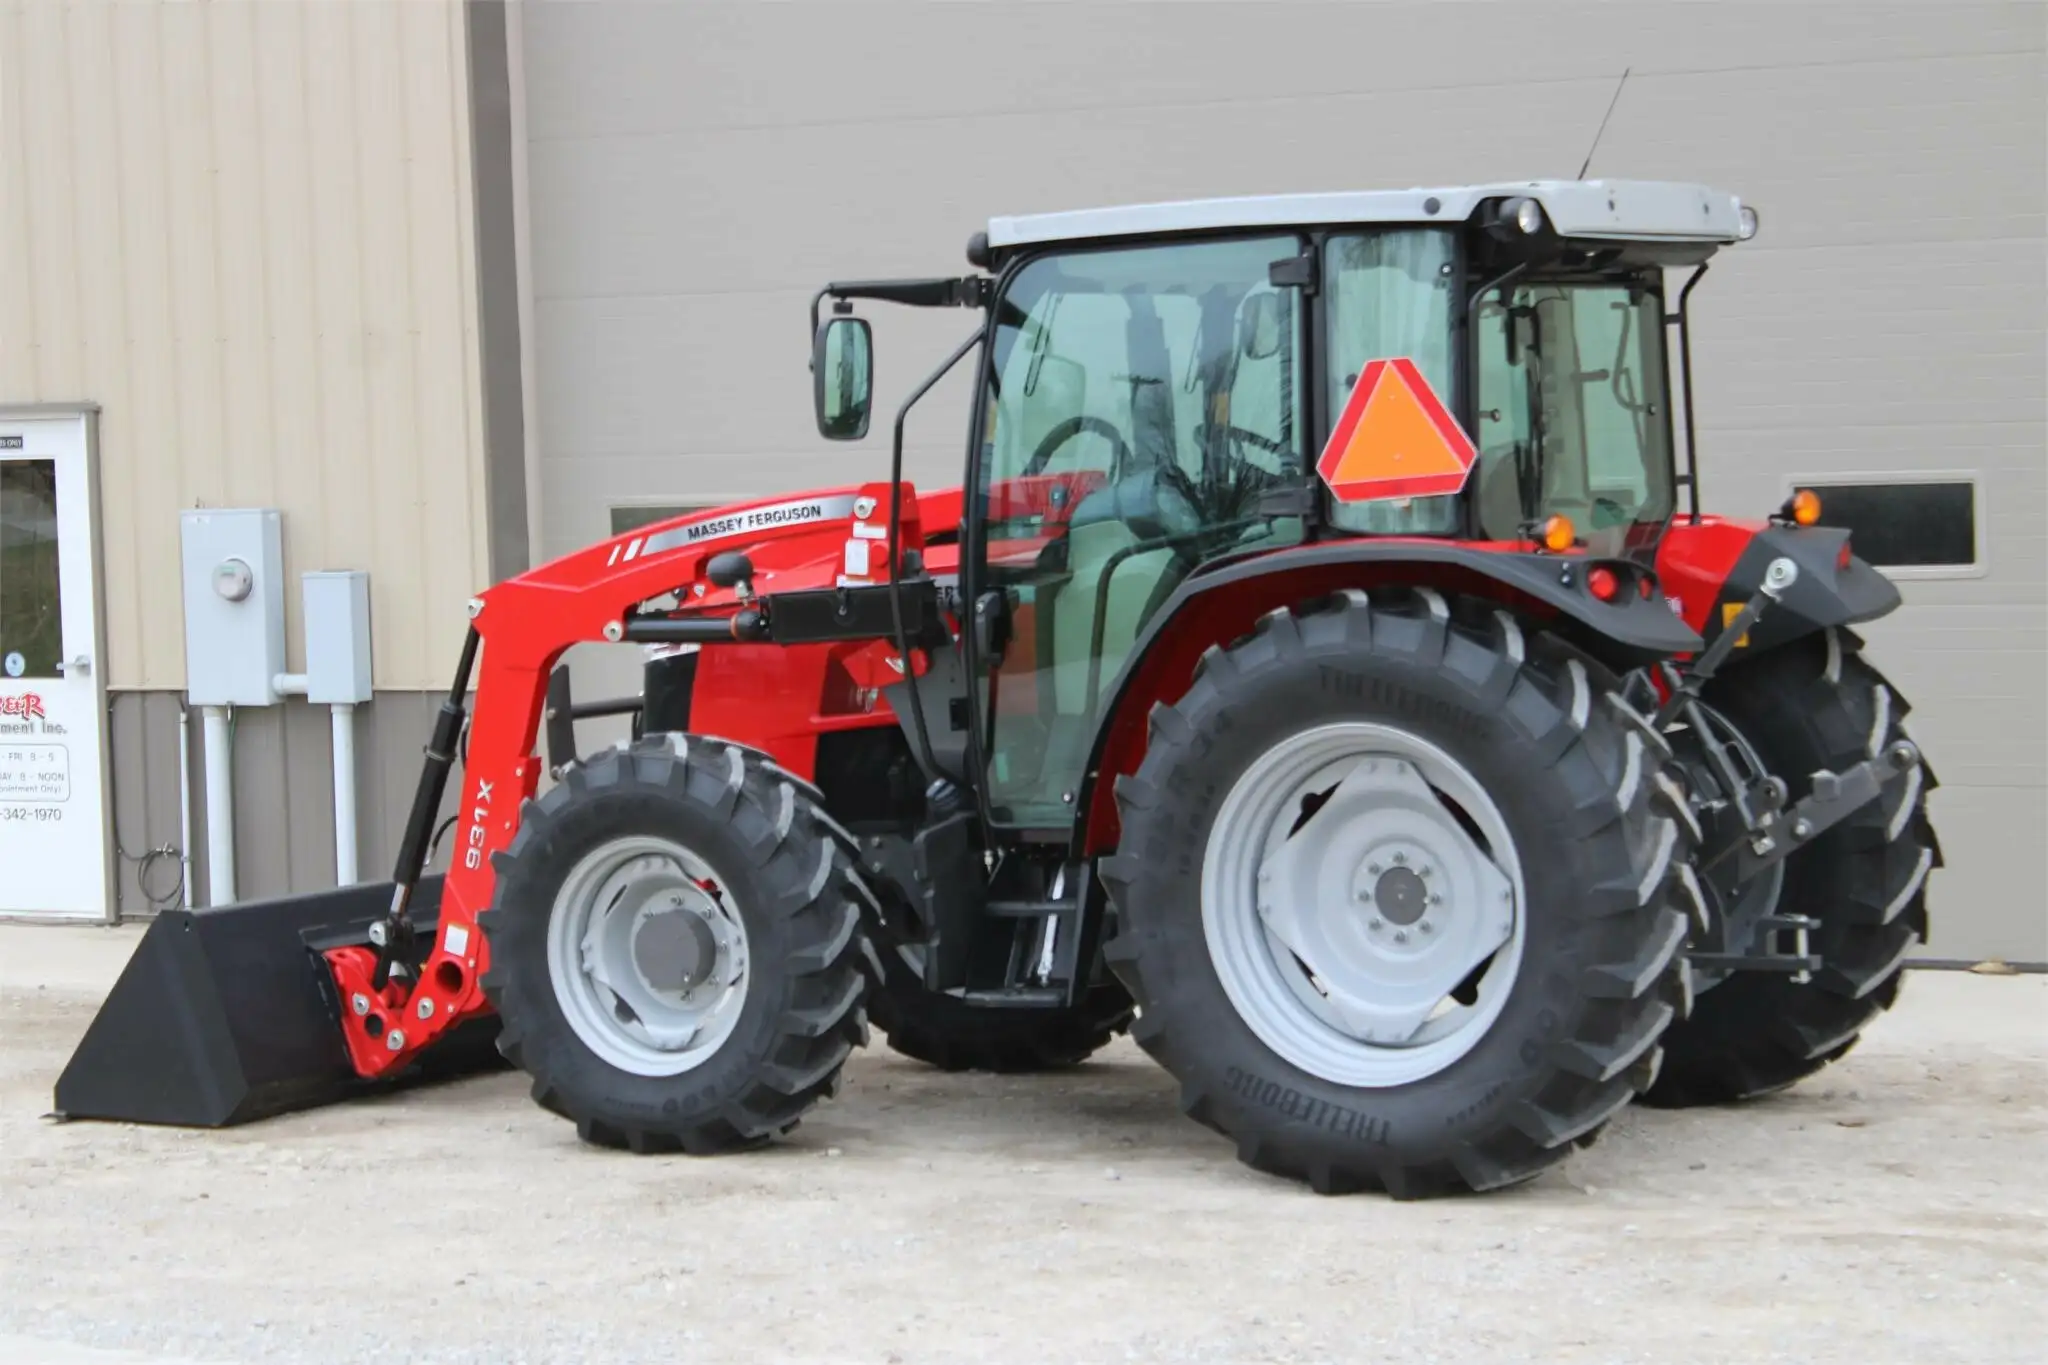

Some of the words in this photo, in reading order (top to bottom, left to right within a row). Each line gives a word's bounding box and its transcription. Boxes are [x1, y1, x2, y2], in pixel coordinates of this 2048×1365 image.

[687, 517, 742, 541] MASSEY
[747, 505, 821, 528] FERGUSON
[42, 720, 68, 735] Inc.
[38, 771, 64, 782] NOON
[465, 777, 494, 870] 931X
[1223, 1065, 1392, 1147] TRELLEBORG
